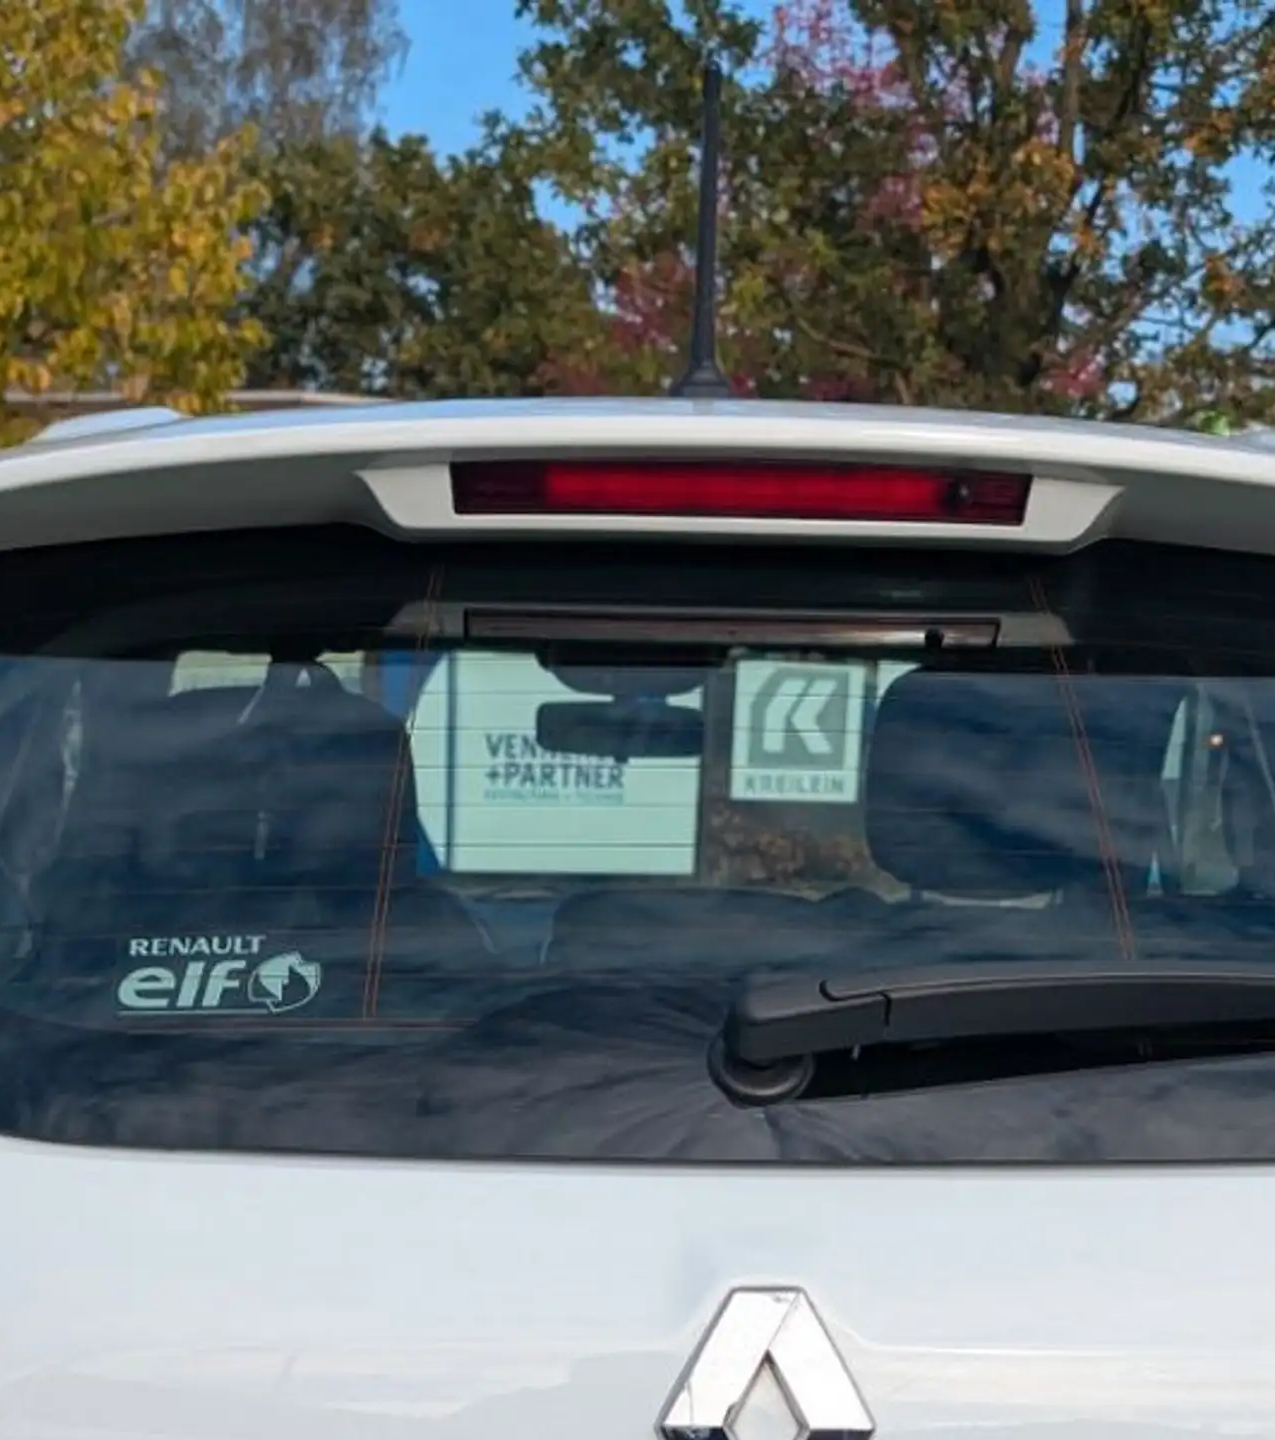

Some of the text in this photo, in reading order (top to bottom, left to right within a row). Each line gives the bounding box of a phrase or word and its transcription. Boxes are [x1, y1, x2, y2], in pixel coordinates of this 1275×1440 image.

[484, 763, 624, 788] +PARTNER
[129, 935, 266, 957] RENAULT
[118, 960, 246, 1008] elf
